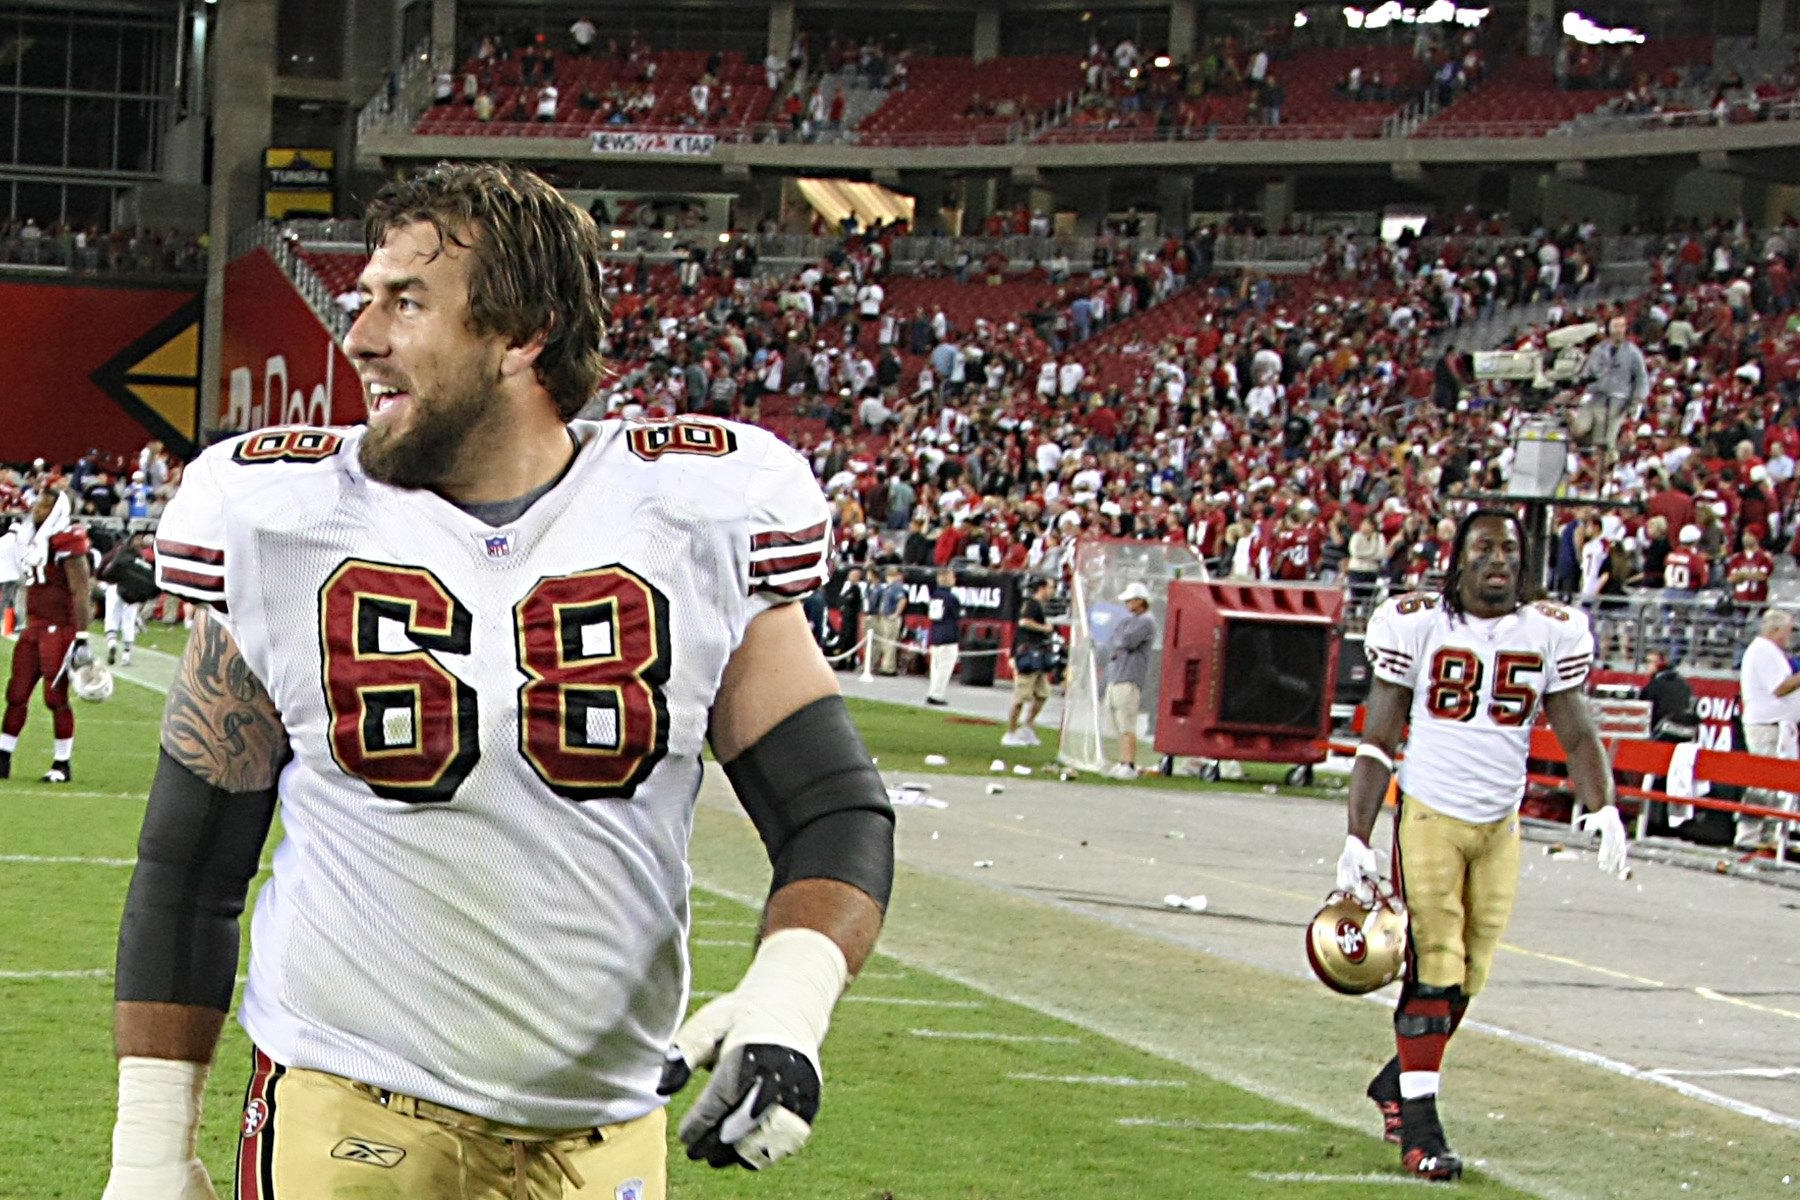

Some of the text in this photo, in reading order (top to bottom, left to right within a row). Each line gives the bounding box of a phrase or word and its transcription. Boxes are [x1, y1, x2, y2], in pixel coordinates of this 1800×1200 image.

[270, 170, 330, 182] TUNDRA
[317, 556, 670, 803] 68
[1426, 644, 1544, 728] 85
